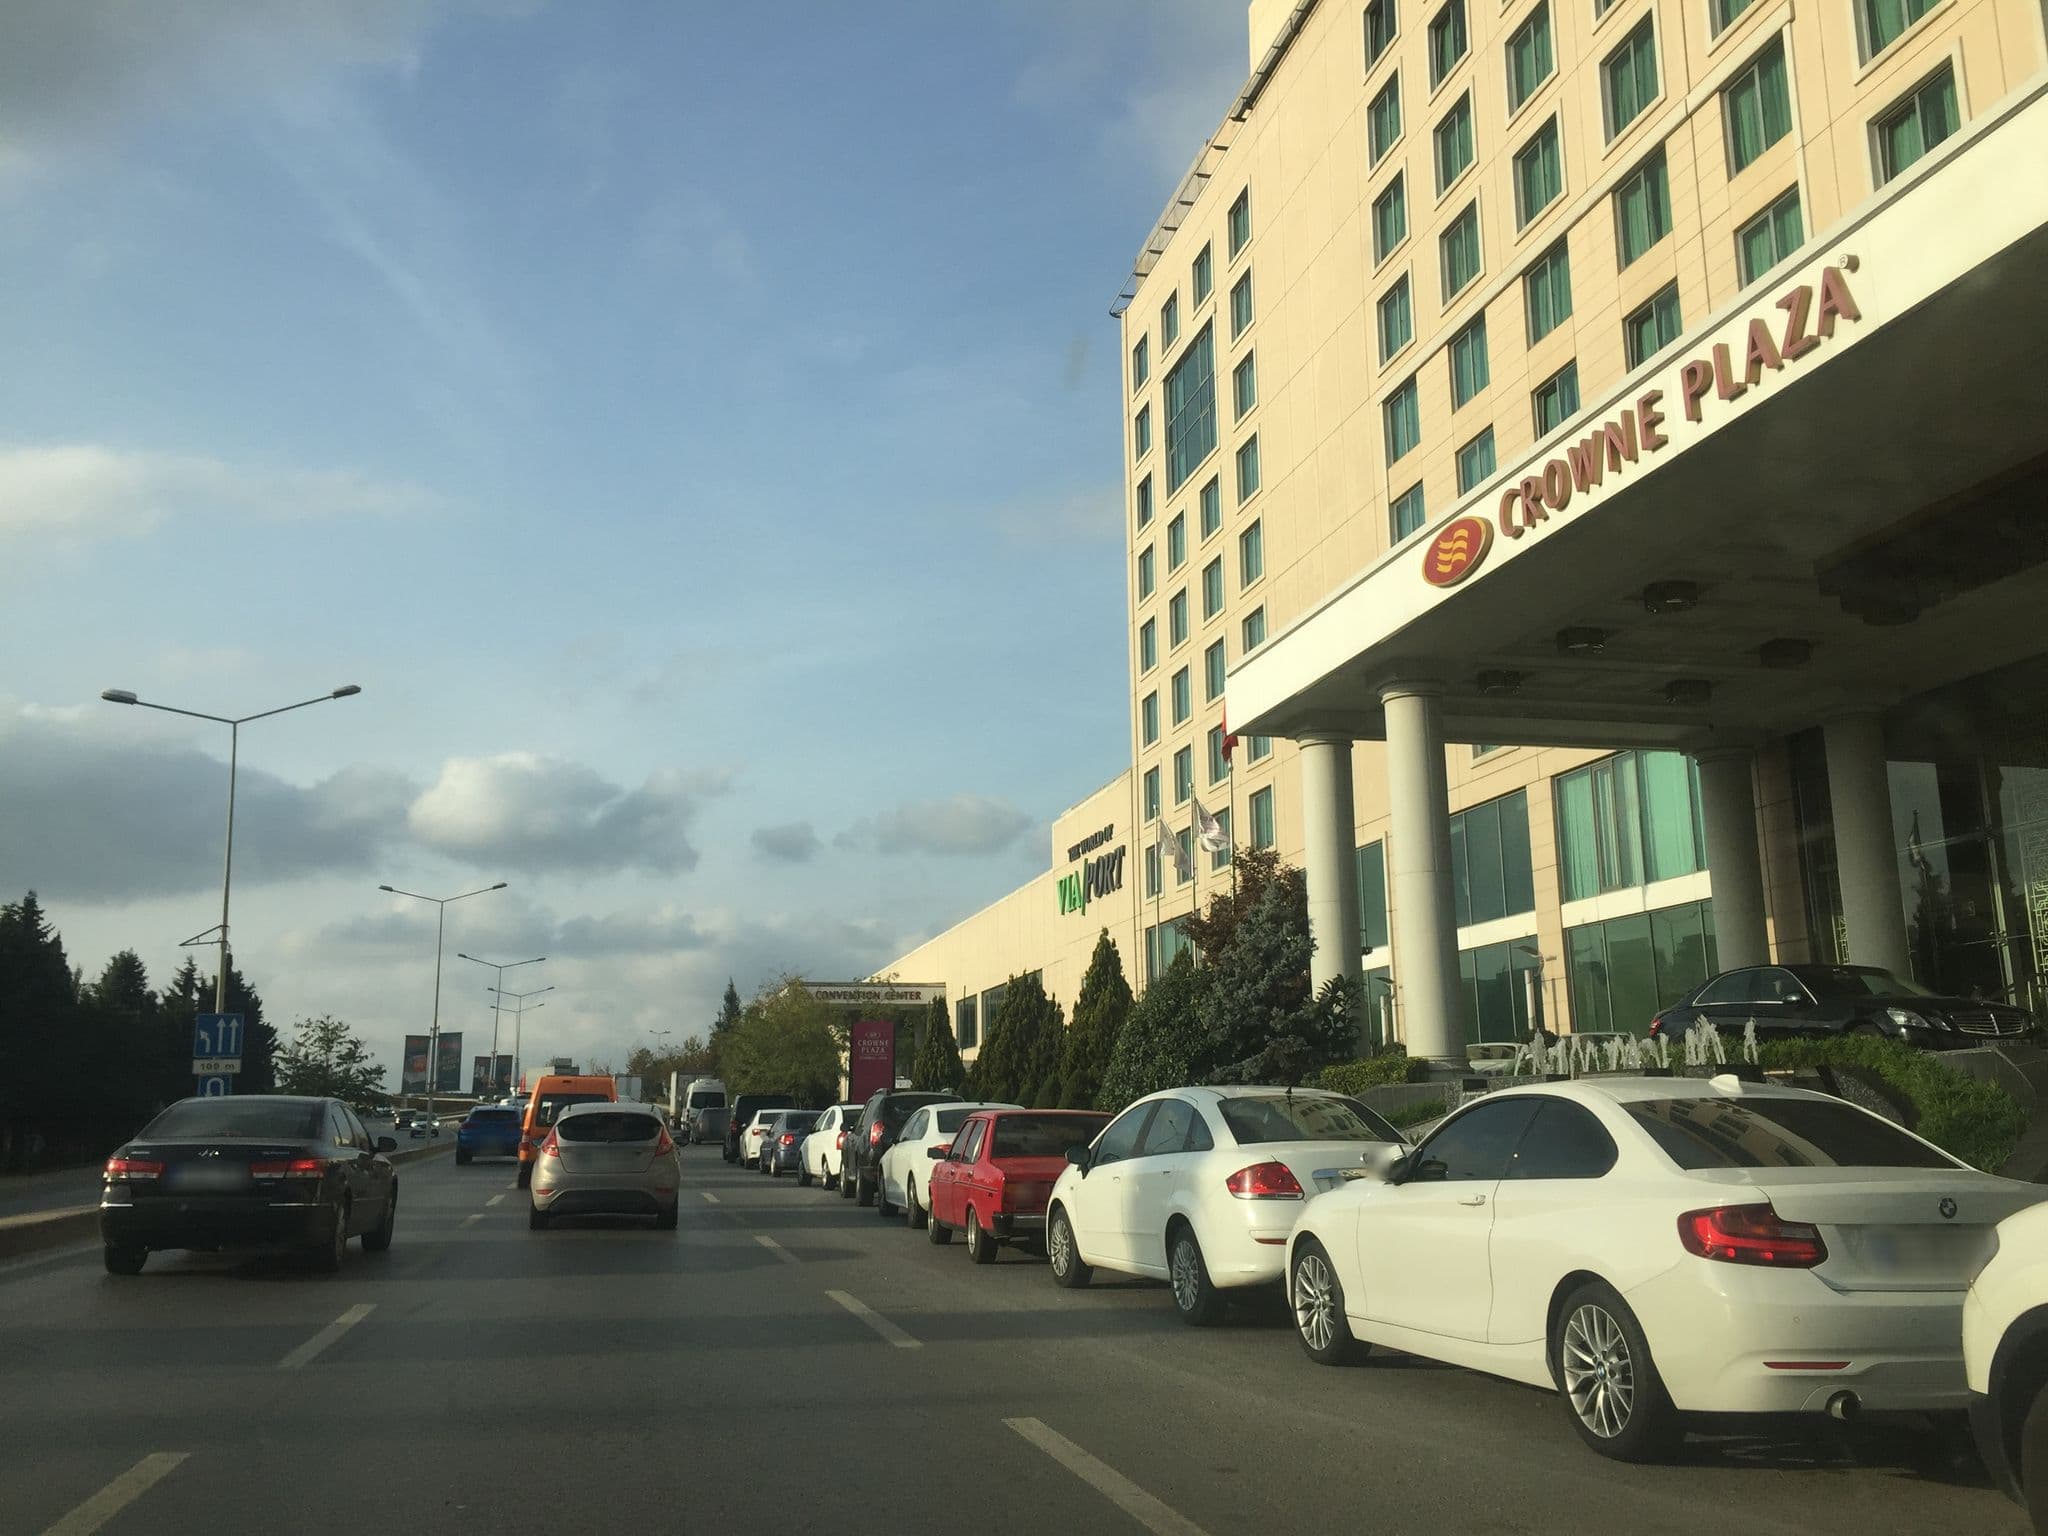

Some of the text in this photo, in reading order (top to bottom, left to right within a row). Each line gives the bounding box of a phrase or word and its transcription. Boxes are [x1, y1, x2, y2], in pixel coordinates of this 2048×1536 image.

[1499, 389, 1669, 539] CROWNE
[1080, 829, 1104, 855] WORLD
[815, 990, 922, 1001] CONVENTION CENTER
[857, 1039, 889, 1047] CROWNE
[861, 1046, 886, 1054] PLAZA
